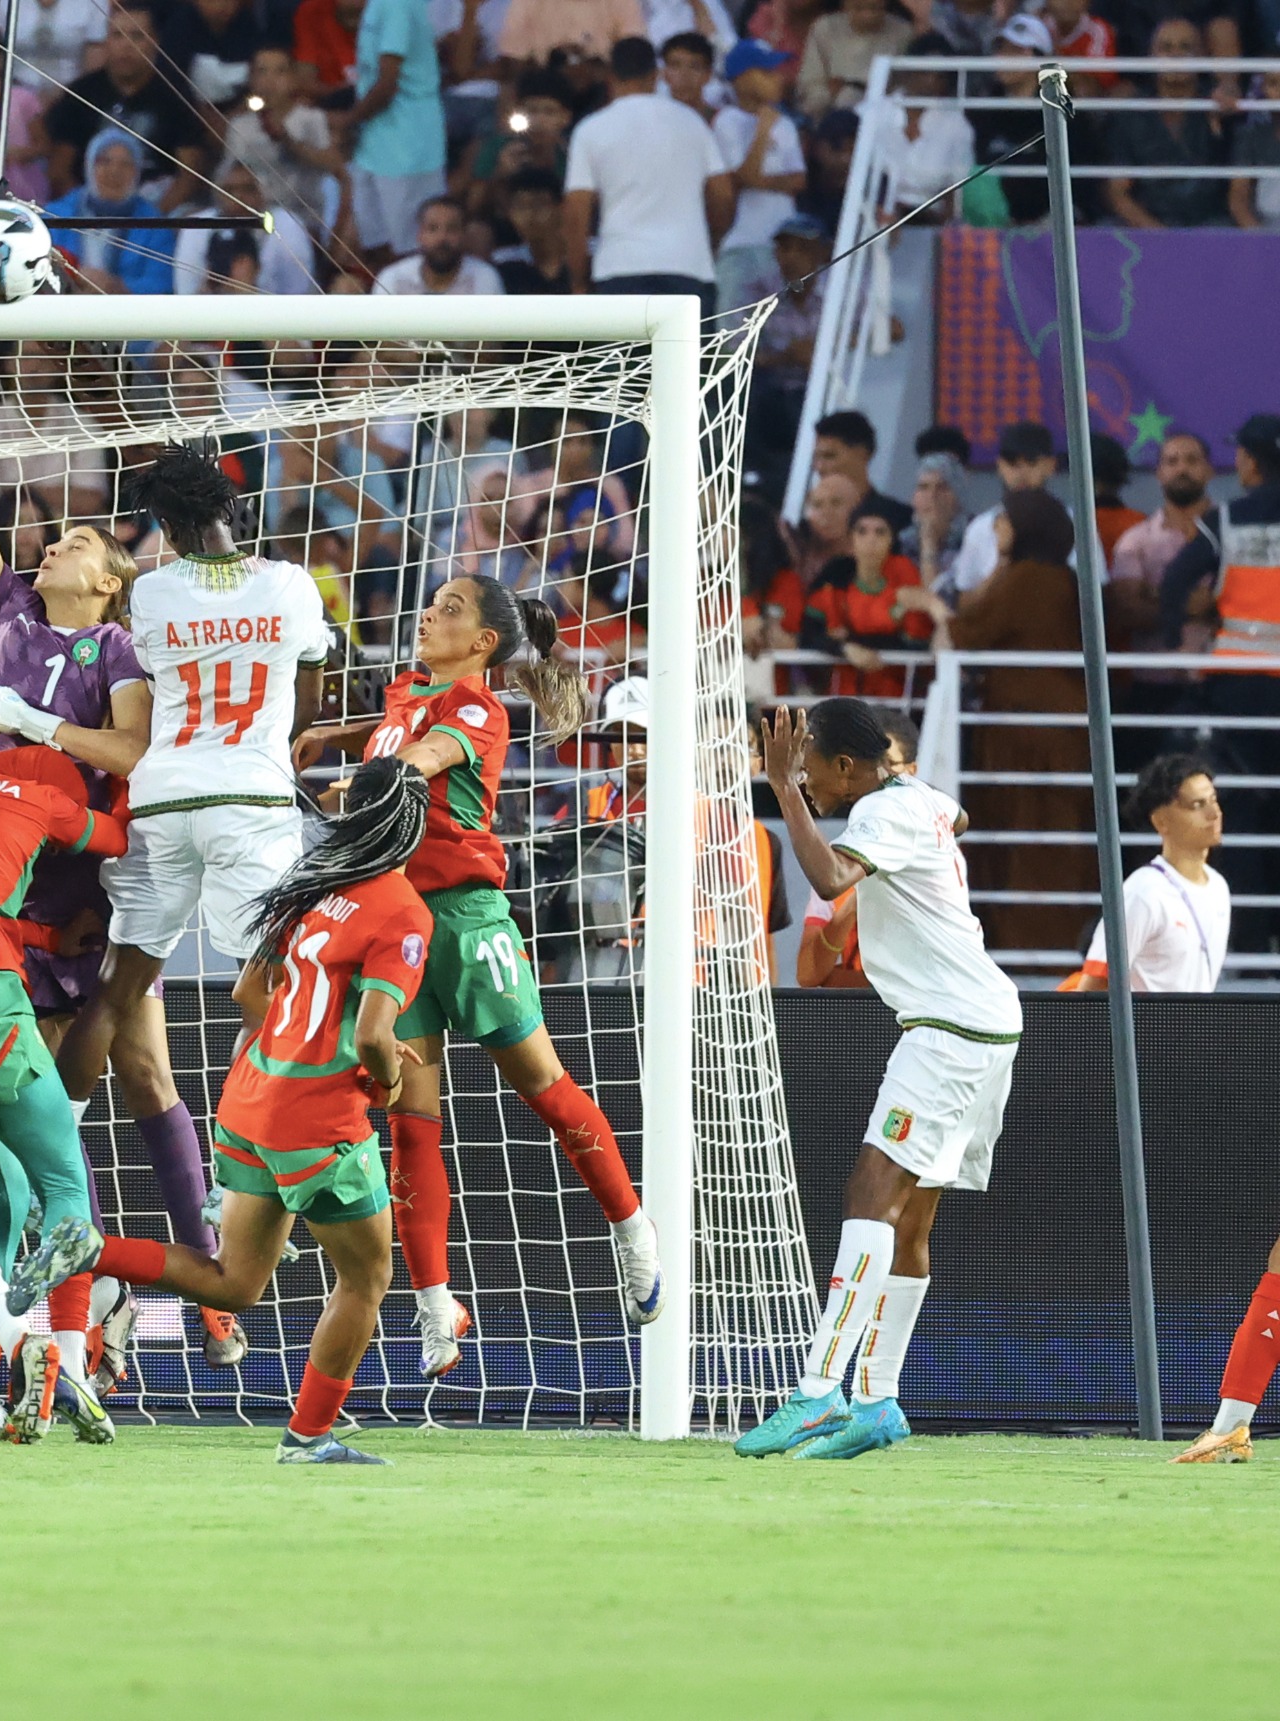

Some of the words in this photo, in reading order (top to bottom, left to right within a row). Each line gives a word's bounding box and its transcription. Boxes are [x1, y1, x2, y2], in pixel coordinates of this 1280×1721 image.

[167, 615, 282, 649] A.TRAORE
[42, 654, 66, 706] 1
[175, 661, 269, 748] 14
[274, 923, 331, 1042] 11
[476, 932, 519, 993] 19
